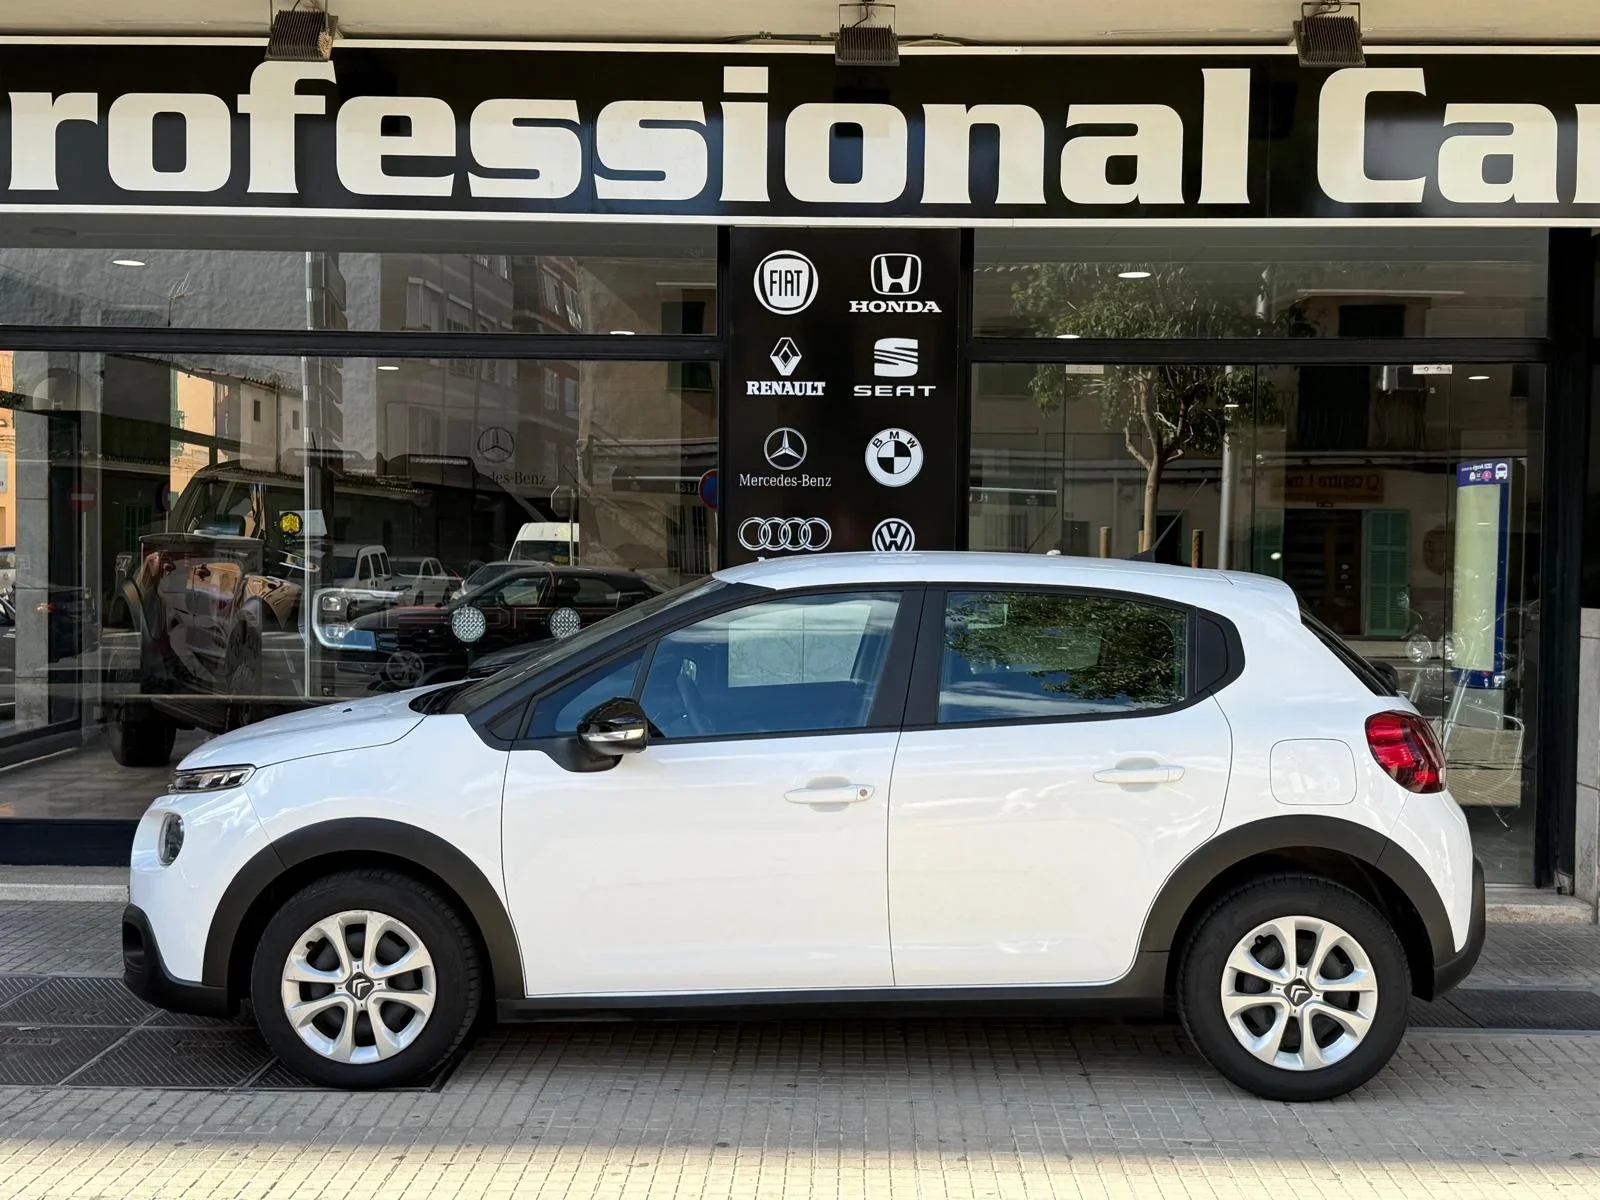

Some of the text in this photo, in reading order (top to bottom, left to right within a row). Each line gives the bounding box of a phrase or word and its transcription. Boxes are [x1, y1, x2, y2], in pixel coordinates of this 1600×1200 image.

[8, 60, 1600, 205] rofessional Ca
[769, 270, 803, 297] FIAT
[849, 300, 942, 313] HONDA
[746, 381, 826, 396] RENAULT
[853, 385, 937, 397] SEAT
[872, 431, 918, 449] BMW
[739, 473, 832, 487] Mercedes-Benz
